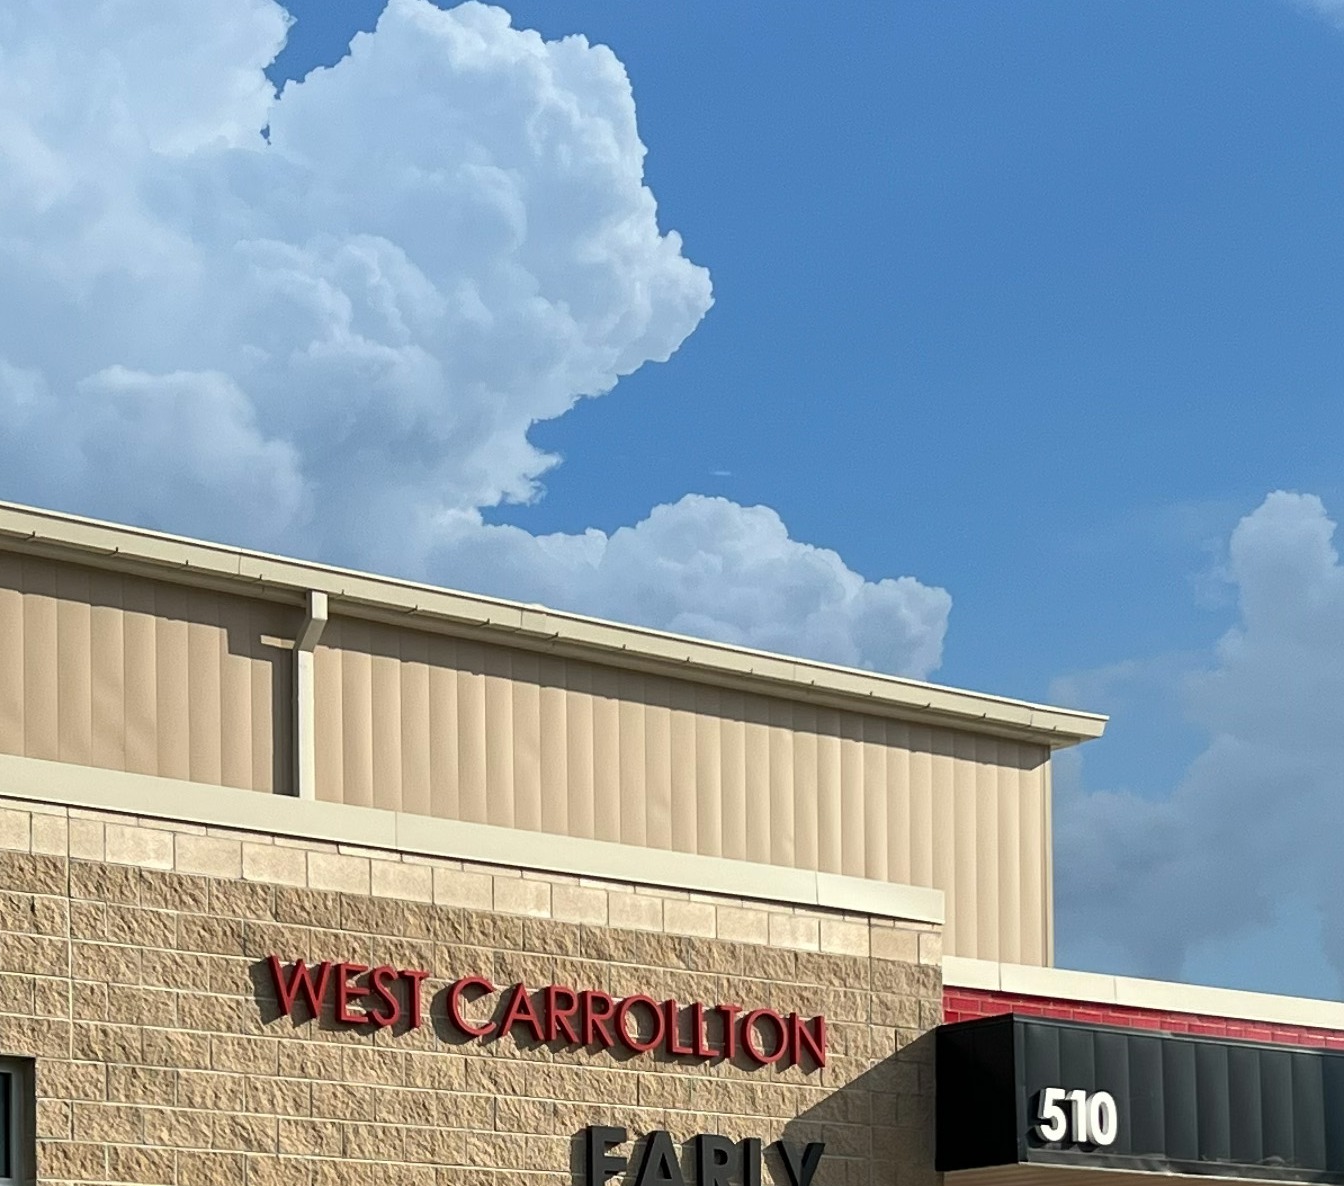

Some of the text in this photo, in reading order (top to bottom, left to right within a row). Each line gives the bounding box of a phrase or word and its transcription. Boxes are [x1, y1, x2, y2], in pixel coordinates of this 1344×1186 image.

[268, 955, 826, 1068] WEST CARROLLTON
[1035, 1087, 1117, 1145] 510
